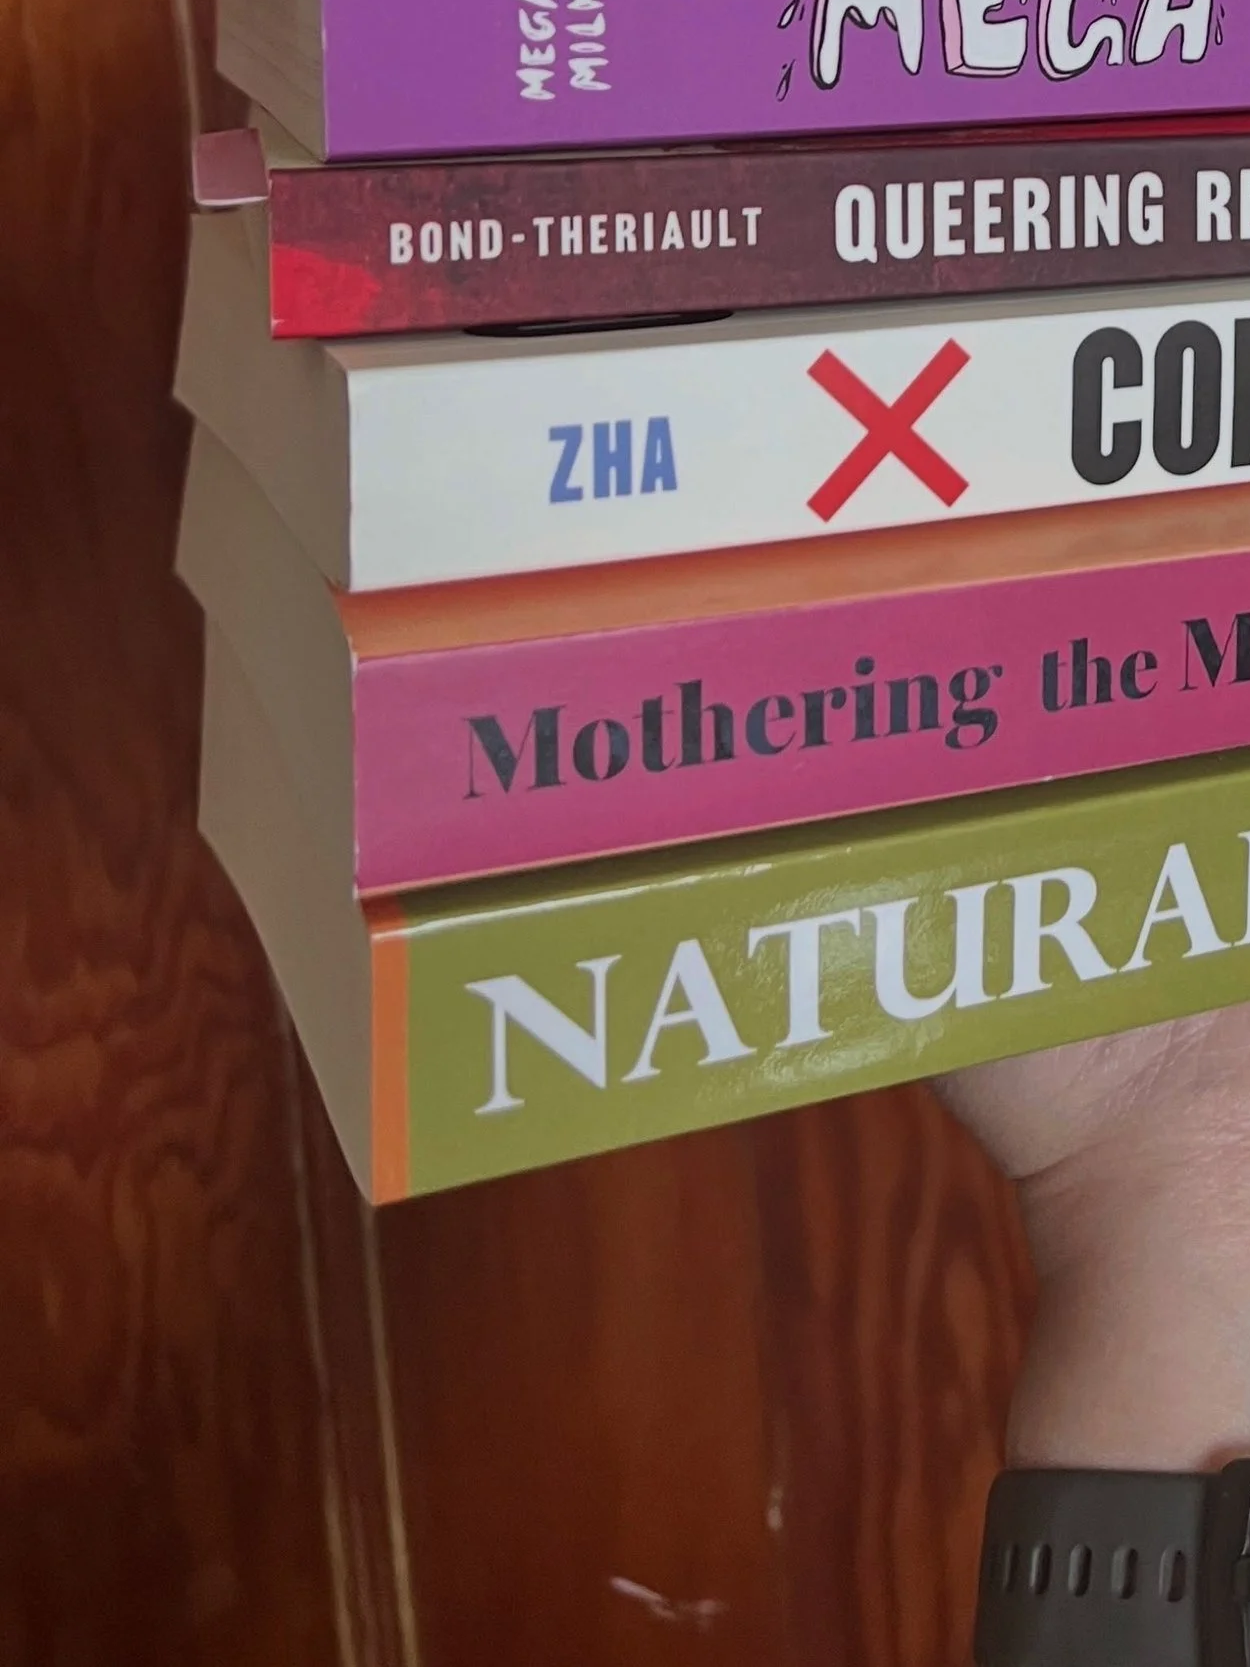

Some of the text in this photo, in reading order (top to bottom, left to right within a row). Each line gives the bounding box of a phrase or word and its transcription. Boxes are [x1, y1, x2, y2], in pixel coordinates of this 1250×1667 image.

[389, 206, 763, 265] BOND-THERIAULT
[834, 170, 1165, 264] QUEERING
[548, 415, 678, 505] ZHA
[462, 655, 1004, 801] Mothering
[1040, 637, 1159, 714] the
